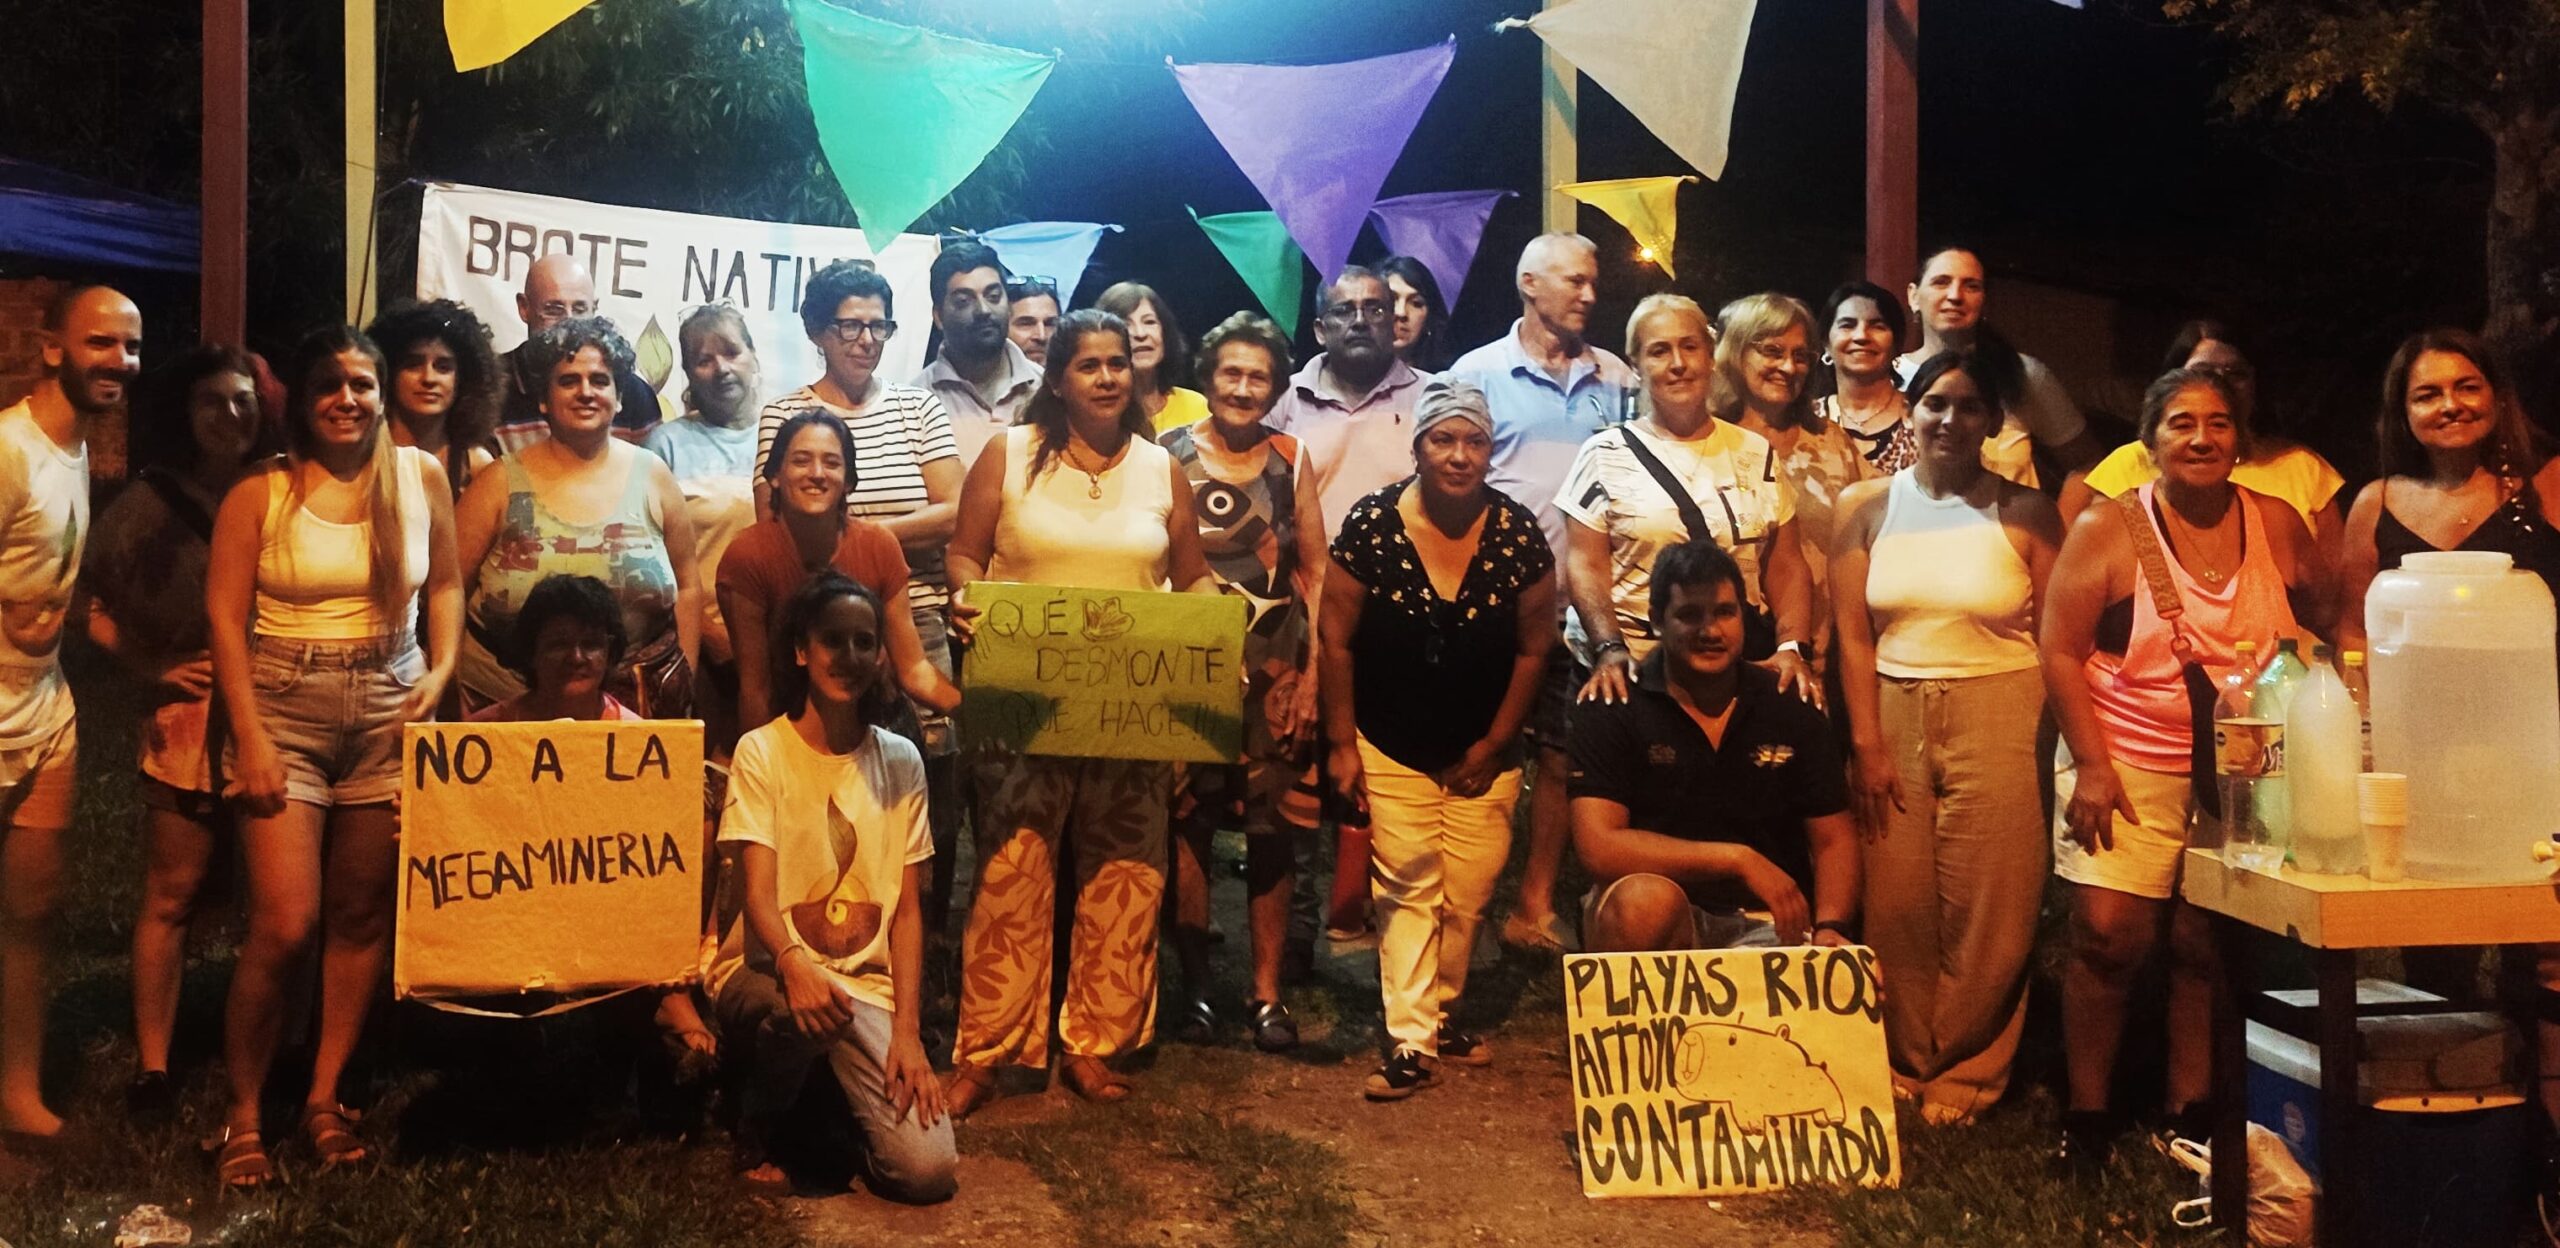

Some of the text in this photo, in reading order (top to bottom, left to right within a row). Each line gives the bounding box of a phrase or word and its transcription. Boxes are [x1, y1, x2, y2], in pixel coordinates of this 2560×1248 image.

[682, 244, 876, 313] NATI
[1036, 644, 1225, 688] DESMONTE
[415, 730, 671, 791] NO A LA
[406, 832, 686, 911] MEGAMINERIA
[1762, 948, 1883, 1025] RÍOS
